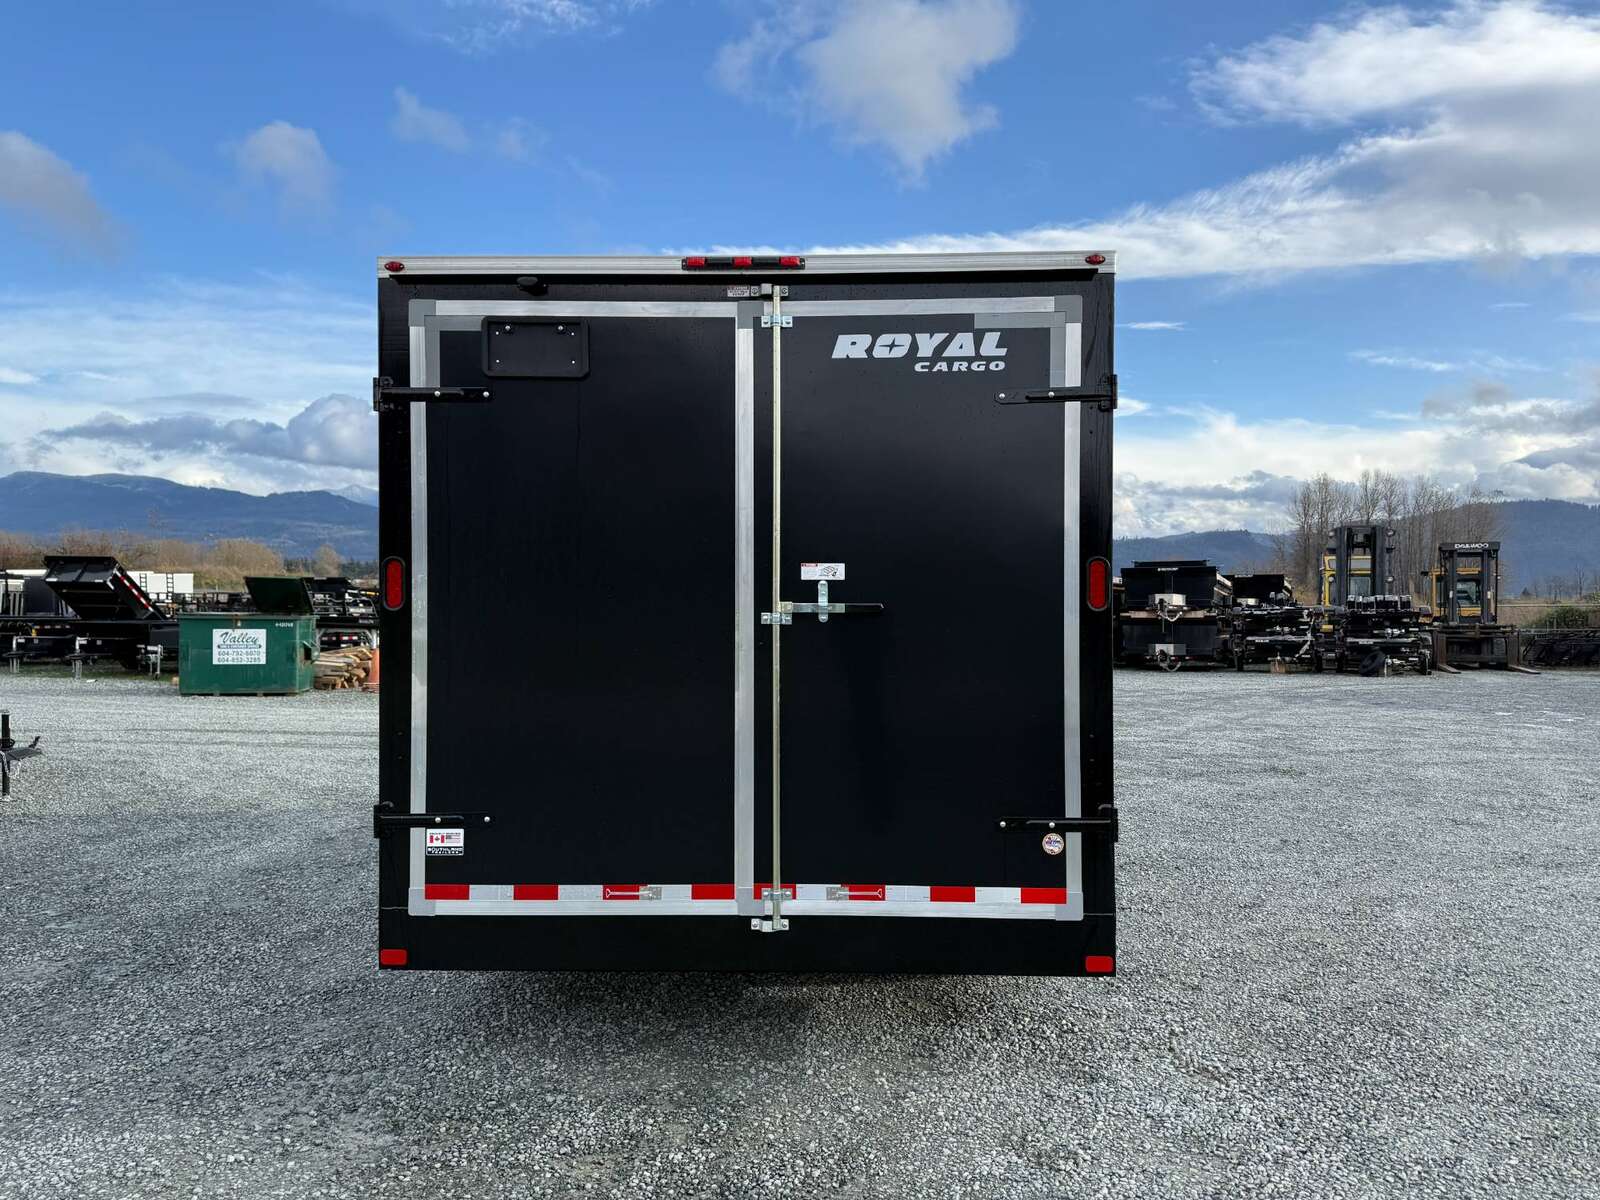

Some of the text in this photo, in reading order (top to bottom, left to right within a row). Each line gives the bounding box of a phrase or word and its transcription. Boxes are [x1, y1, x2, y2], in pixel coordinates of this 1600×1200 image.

[831, 331, 1008, 358] ROYAL
[914, 361, 1006, 372] CARGO
[220, 631, 259, 644] Valley
